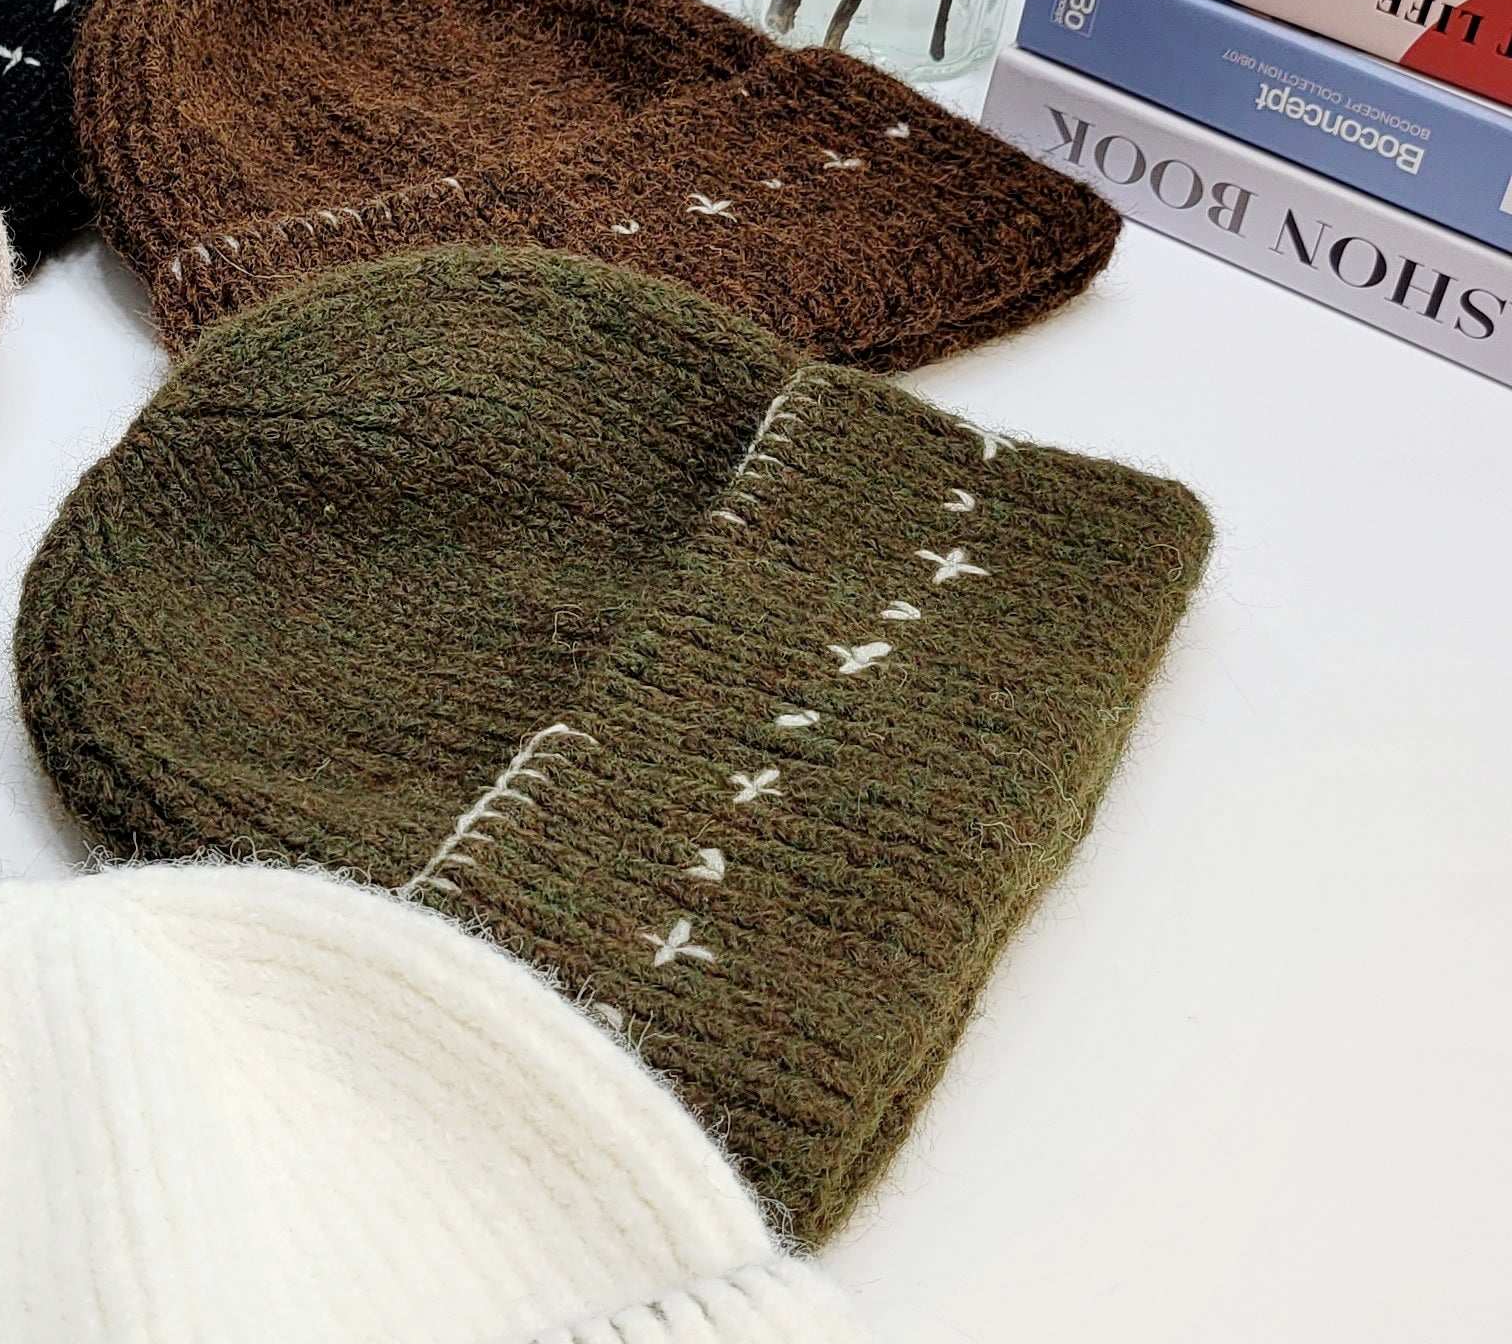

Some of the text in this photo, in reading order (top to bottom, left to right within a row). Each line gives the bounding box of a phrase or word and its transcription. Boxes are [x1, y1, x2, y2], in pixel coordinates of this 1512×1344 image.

[1255, 63, 1342, 105] COLLECTION
[1254, 83, 1426, 176] Boconcept
[1344, 100, 1432, 142] BOCONCEPT
[1042, 104, 1512, 340] SHON BOOK
